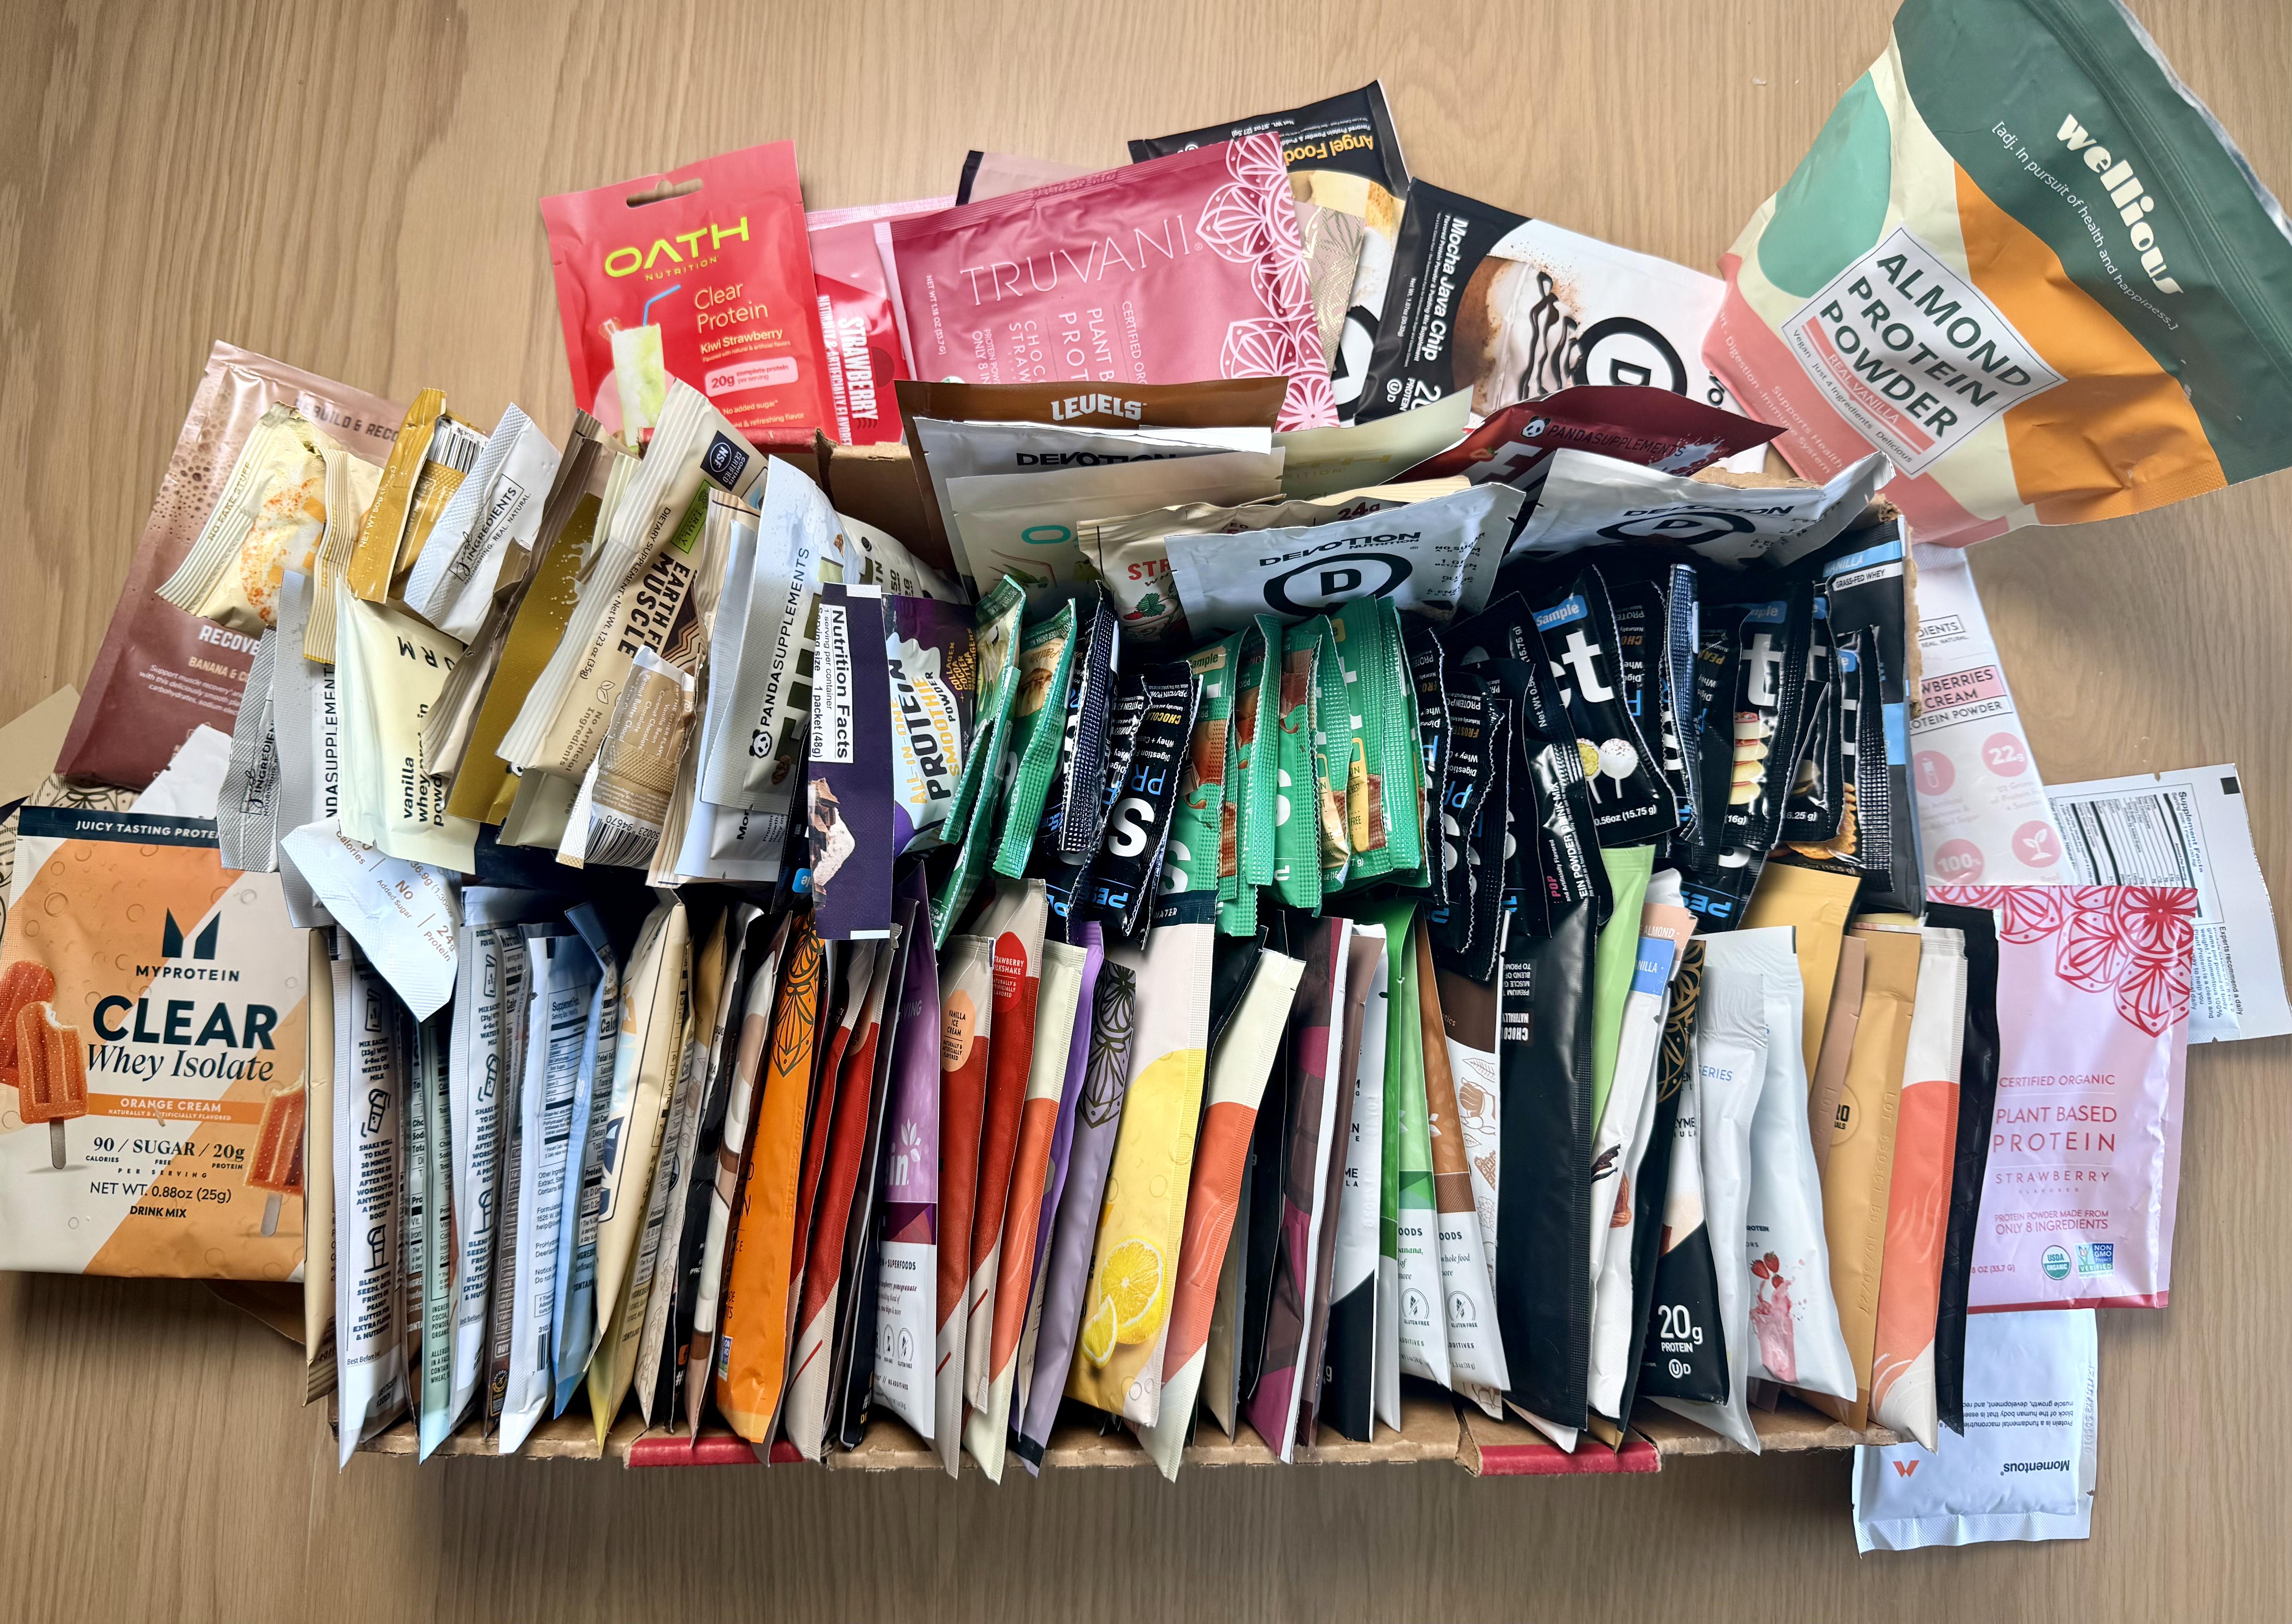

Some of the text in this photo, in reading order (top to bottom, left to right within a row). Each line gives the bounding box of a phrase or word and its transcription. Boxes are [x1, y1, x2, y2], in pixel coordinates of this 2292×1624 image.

[1304, 130, 1326, 140] Powder
[1326, 127, 1348, 136] Protein
[1349, 124, 1371, 133] Flavored
[1283, 136, 1373, 167] Angel Food
[2057, 114, 2184, 294] wellious
[1440, 214, 1451, 241] Flavored
[1991, 121, 2179, 331] [adj. In pursuit of health and happiness.]
[604, 216, 750, 277] OATH
[1436, 240, 1445, 262] Protein
[1443, 217, 1470, 275] Mocha
[646, 257, 717, 281] NUTRITION
[1432, 261, 1441, 283] Powder
[694, 283, 743, 310] Clear
[1424, 288, 1435, 313] Pudding
[1434, 276, 1454, 318] Java
[698, 300, 769, 334] Protein
[1122, 301, 1141, 359] CERTIFIED
[1877, 254, 2031, 387] ALMOND
[700, 329, 783, 354] Kiwi Strawberry
[972, 331, 986, 359] ONLY
[984, 329, 995, 360] PROTEIN
[1087, 309, 1112, 364] PLANT
[1413, 324, 1428, 362] Supplement
[1423, 320, 1447, 362] Chip
[1847, 276, 1998, 407] PROTEIN
[736, 364, 789, 377] complete protein
[837, 317, 879, 421] STRAWBERRY
[1725, 334, 1761, 389] Digestion
[1820, 299, 1957, 438] POWDER
[711, 373, 735, 389] 20g
[1399, 378, 1415, 412] PROTEIN
[1827, 354, 1900, 425] REAL VANILLA
[1050, 393, 1141, 421] LEVELS
[1772, 386, 1811, 434] Supports
[1793, 329, 1811, 358] Vegan
[1811, 363, 1826, 382] Just
[1831, 385, 1873, 429] Ingredients
[1875, 431, 1913, 463] Delicious
[750, 416, 785, 427] refreshing
[785, 413, 805, 421] flavor
[1547, 425, 1688, 458] PANDASUPPLEMENTS
[208, 461, 252, 541] NO FAKE STUFF
[618, 506, 671, 594] DIETARY SUPPLEMENT
[1259, 531, 1421, 567] DEVOTION
[1349, 539, 1419, 549] NUTRITION
[1320, 569, 1362, 596] D
[1835, 568, 1885, 589] GRASS-FED WHEY
[617, 551, 673, 659] MUSCLE
[652, 560, 691, 631] EARTH
[580, 599, 621, 680] Net Wt. 1.23 oz (35g)
[760, 547, 810, 728] PANDASUPPLEMENTS
[628, 674, 651, 719] Peanut Butter
[832, 610, 851, 759] Nutrition Facts
[925, 671, 956, 722] POWDER
[1924, 688, 1978, 709] CREAM
[634, 701, 652, 733] Chocolate
[1953, 701, 2003, 719] POWDER
[559, 707, 595, 766] Ingredients
[888, 659, 952, 801] PROTEIN
[911, 677, 960, 777] SMOOTHIE
[565, 711, 603, 772] No Artificial
[1141, 750, 1171, 762] Digestion
[401, 756, 415, 819] vanilla
[416, 774, 430, 823] whey
[376, 879, 412, 918] Added Sugar
[395, 880, 414, 900] No
[423, 931, 451, 962] Protein
[437, 925, 456, 952] 24g
[1643, 927, 1674, 939] ALMOND
[136, 965, 240, 982] MYPROTEIN
[93, 995, 278, 1050] CLEAR
[949, 1010, 966, 1020] VANILLA
[947, 1026, 961, 1037] CREAM
[87, 1043, 275, 1082] Whey Isolate
[1999, 1075, 2115, 1087] CERTIFIED ORGANIC
[120, 1098, 221, 1112] ORANGE CREAM
[1996, 1106, 2117, 1124] PLANT BASED
[94, 1137, 114, 1152] 90
[132, 1139, 195, 1157] SUGAR
[213, 1143, 245, 1162] 20g
[1993, 1132, 2115, 1152] PROTEIN
[152, 1169, 207, 1179] SERVING
[1996, 1171, 2110, 1184] STRAWBERRY
[90, 1181, 232, 1204] NET WT. 0.88oz (25g)
[130, 1205, 187, 1218] DRINK MIX
[370, 1210, 387, 1220] BOOST
[1994, 1213, 2025, 1222] PROTEIN
[2027, 1211, 2058, 1219] POWDER
[1996, 1219, 2108, 1235] ONLY 8 INGREDIENTS
[888, 1259, 916, 1270] SUPERFOODS
[2046, 1263, 2068, 1271] ORGANIC
[2047, 1254, 2064, 1262] USDA
[2080, 1264, 2112, 1272] VERIFIED
[893, 1283, 917, 1293] pomegranate
[1658, 1305, 1703, 1345] 20g
[1661, 1342, 1693, 1353] PROTEIN
[2003, 1460, 2070, 1473] Momentous
